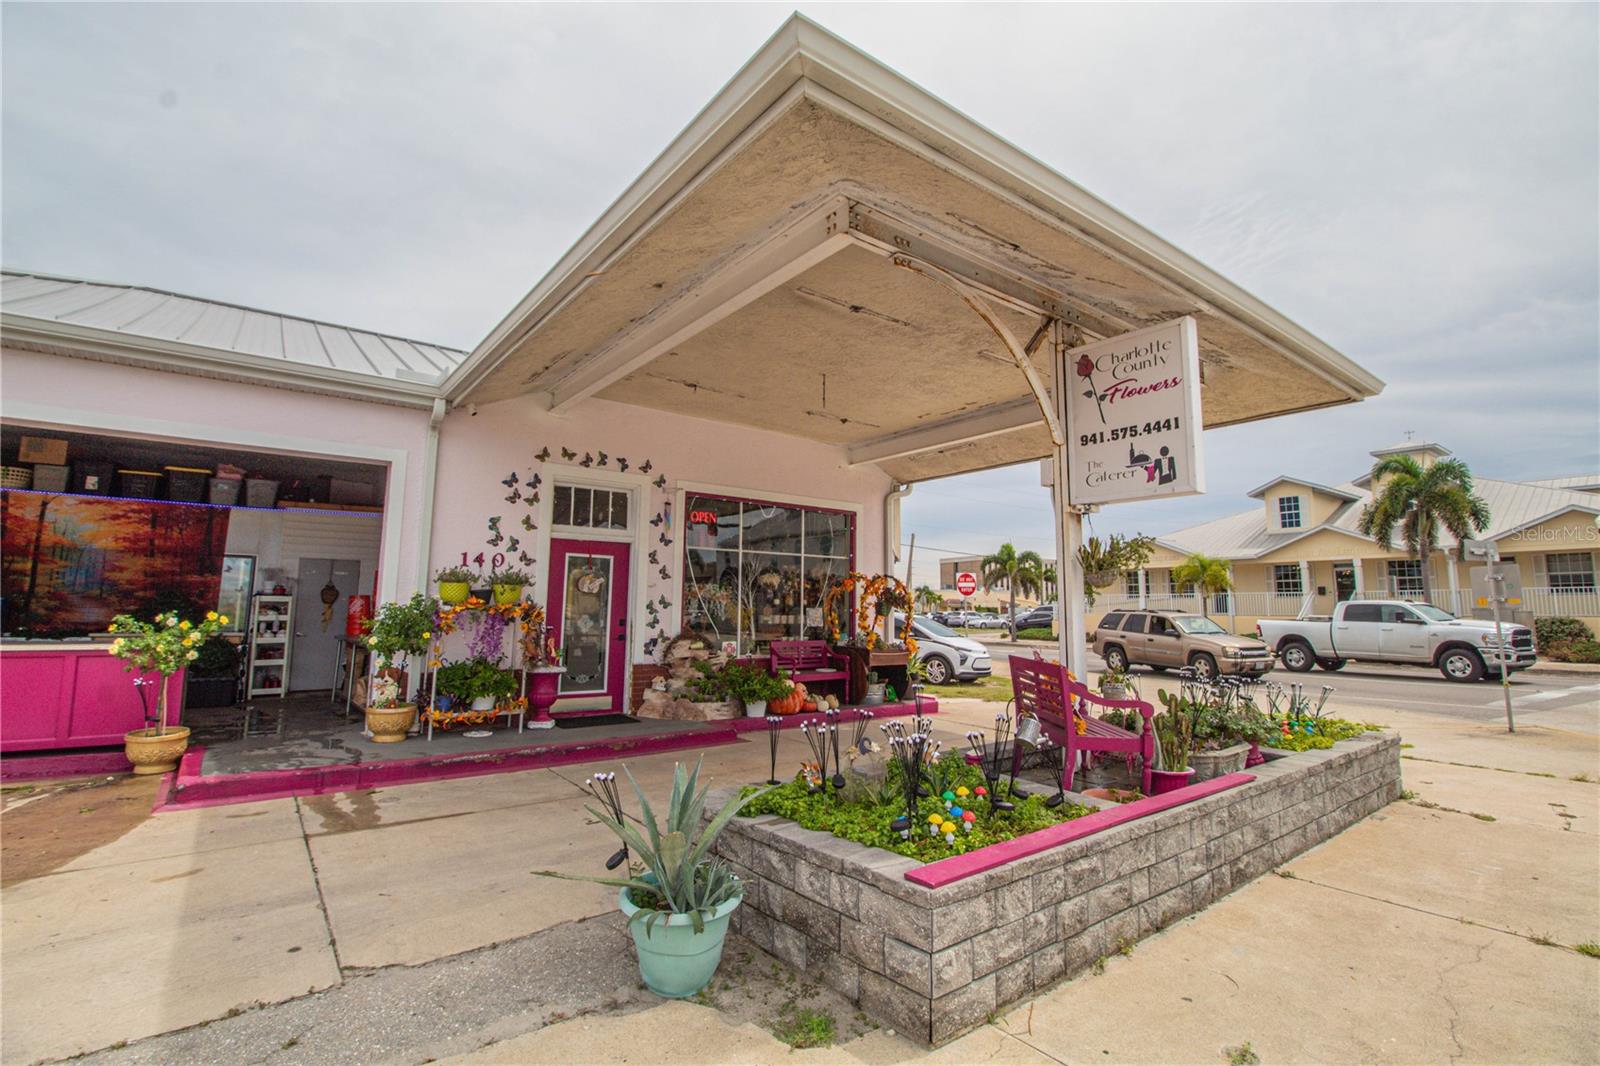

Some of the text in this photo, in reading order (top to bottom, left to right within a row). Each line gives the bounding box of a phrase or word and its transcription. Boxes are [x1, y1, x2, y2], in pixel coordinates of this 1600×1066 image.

[1095, 340, 1172, 373] Charlotte
[1112, 354, 1169, 380] County
[1103, 376, 1182, 404] Flowers
[1080, 417, 1180, 447] 941.575.4441
[1087, 460, 1103, 472] The
[1085, 469, 1137, 488] Caterer
[690, 511, 717, 524] OPEN
[460, 551, 505, 570] 140
